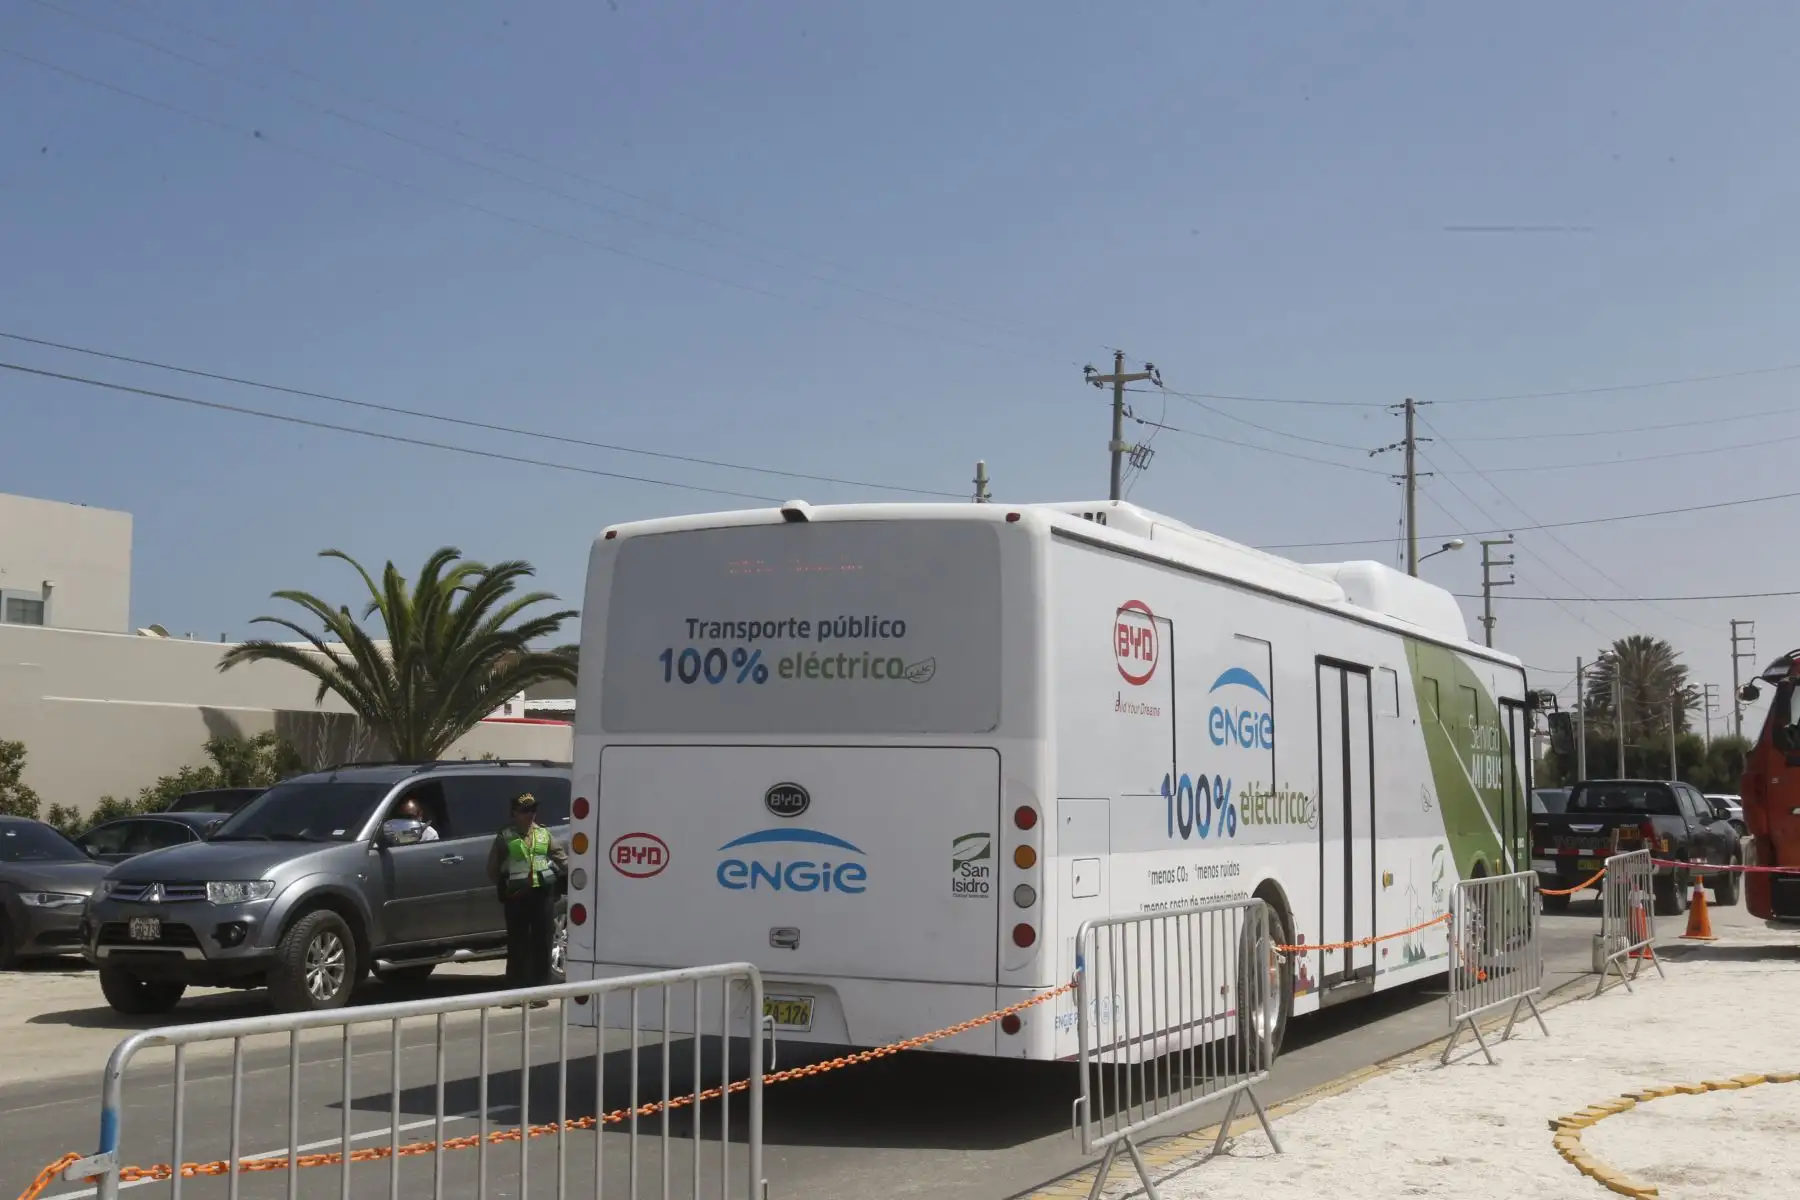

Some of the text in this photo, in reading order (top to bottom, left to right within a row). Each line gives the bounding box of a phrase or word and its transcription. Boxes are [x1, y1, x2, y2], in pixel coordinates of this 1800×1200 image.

[685, 615, 906, 643] Transporte público
[1117, 623, 1152, 661] BYD
[659, 647, 906, 685] 100% eléctrico
[771, 793, 803, 806] BYD
[1160, 772, 1306, 841] 100% eléctrico
[617, 846, 661, 865] BYD
[961, 862, 989, 878] San
[1220, 860, 1240, 878] ruidos
[952, 877, 989, 893] Isidro
